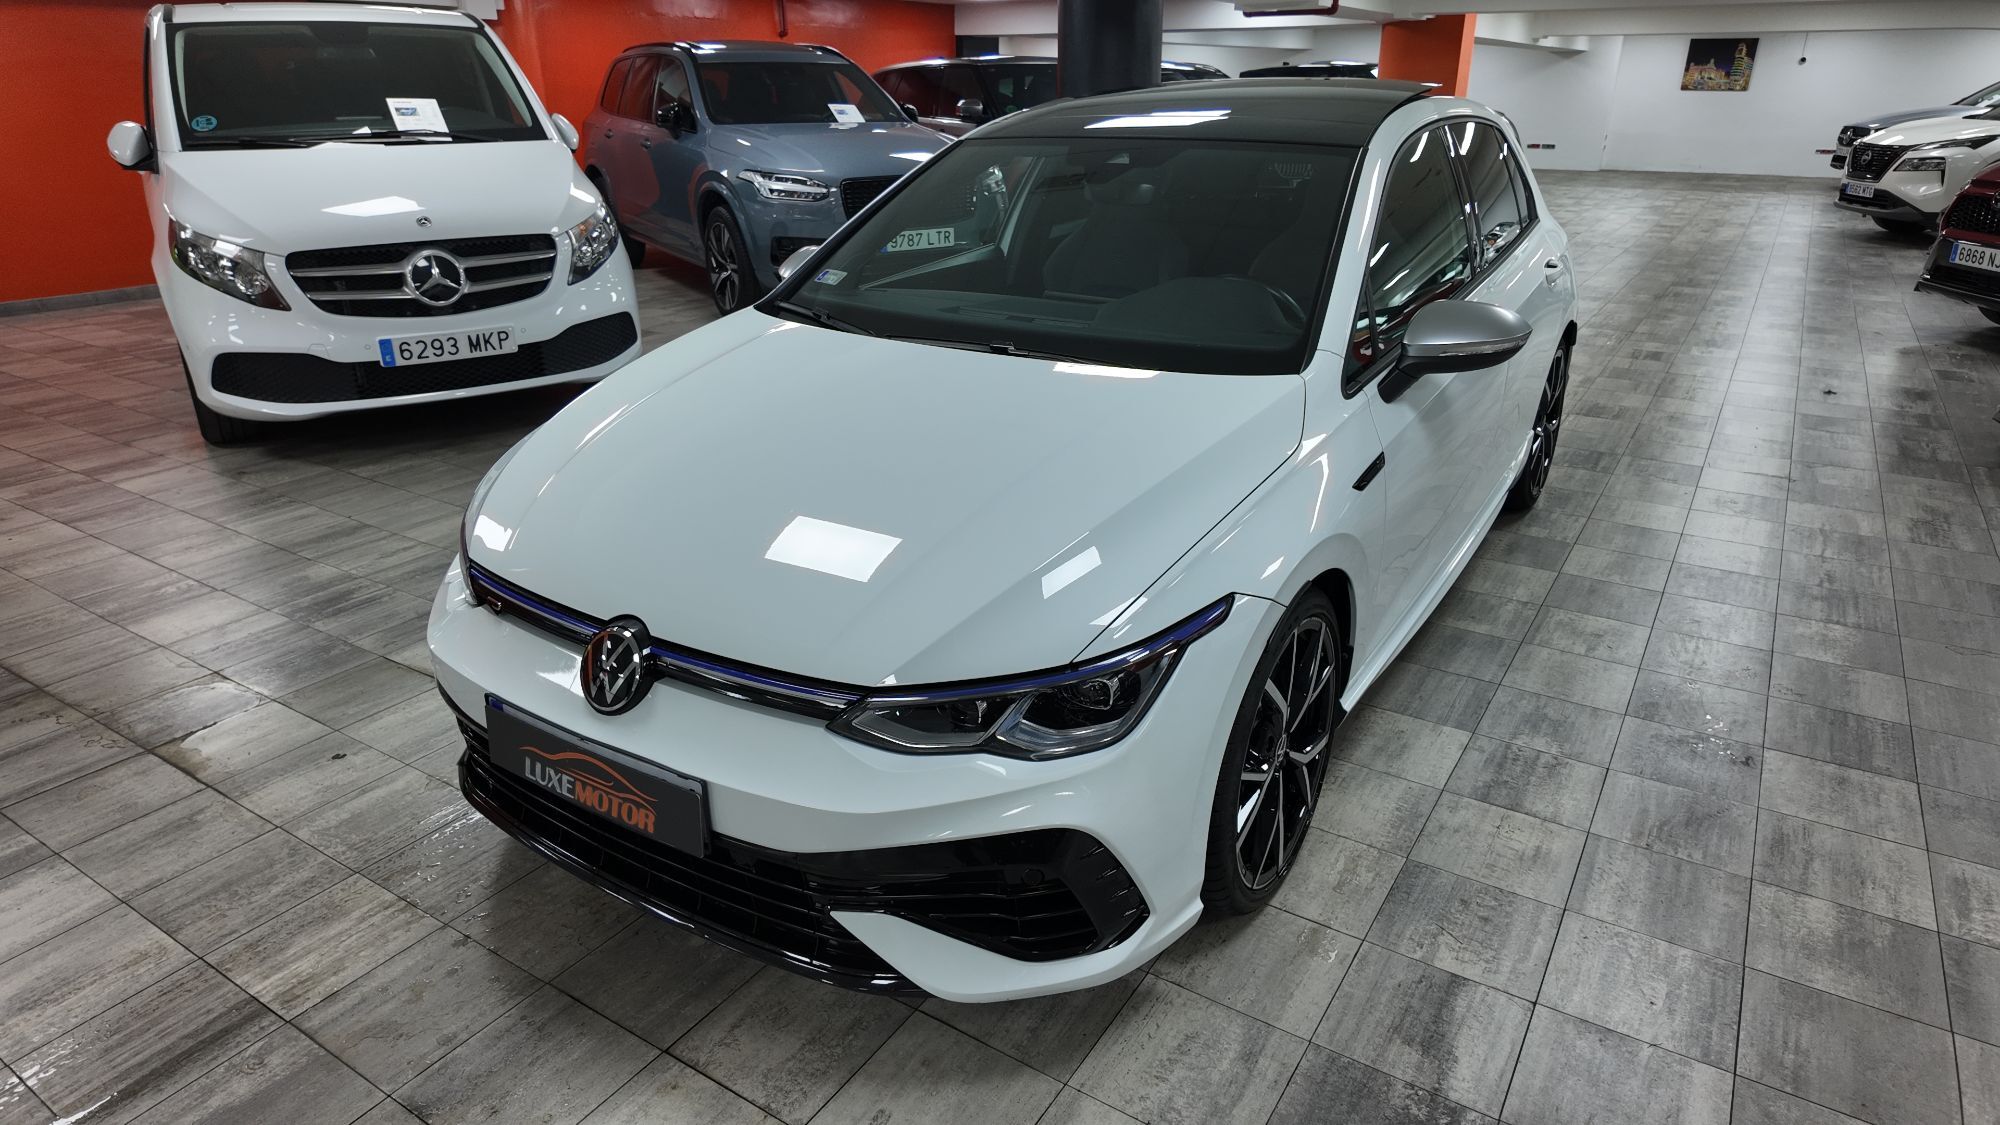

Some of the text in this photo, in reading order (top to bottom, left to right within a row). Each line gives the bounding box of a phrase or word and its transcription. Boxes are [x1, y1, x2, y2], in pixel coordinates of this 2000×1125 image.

[890, 230, 951, 248] 9787 LTR
[1959, 247, 1985, 265] 6868
[399, 331, 509, 360] 6293 MKP
[525, 756, 656, 833] LUXEMOTOR
